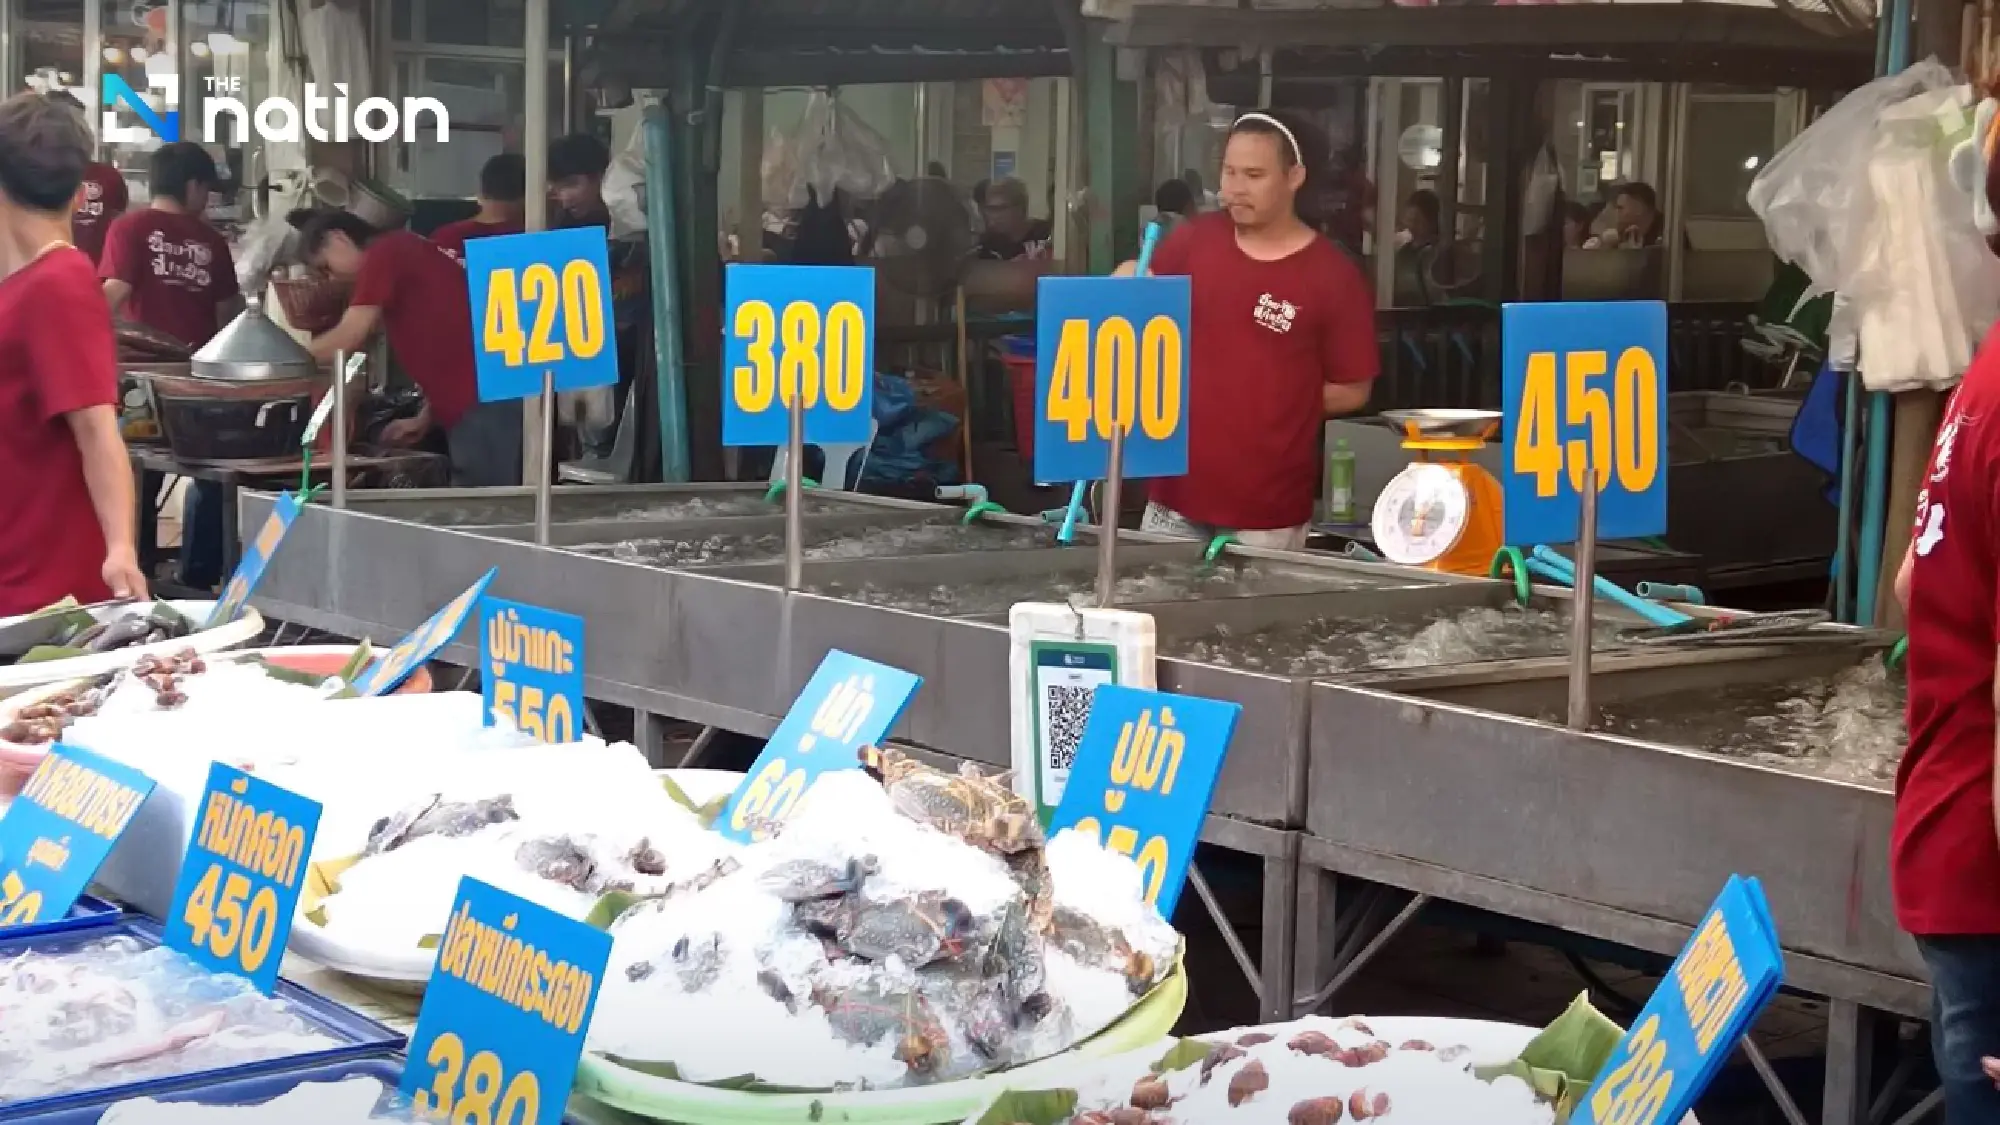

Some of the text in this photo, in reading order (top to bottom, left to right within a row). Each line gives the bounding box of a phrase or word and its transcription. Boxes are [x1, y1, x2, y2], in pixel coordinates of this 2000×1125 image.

[483, 258, 604, 366] 420
[734, 299, 865, 412] 380
[1047, 314, 1181, 441] 400
[1514, 345, 1658, 497] 450
[488, 607, 574, 677] ปูม้าแกะ
[1105, 707, 1186, 814] ปูม้า
[184, 862, 279, 973] 450
[413, 1032, 540, 1125] 380
[1591, 1012, 1675, 1125] 280
